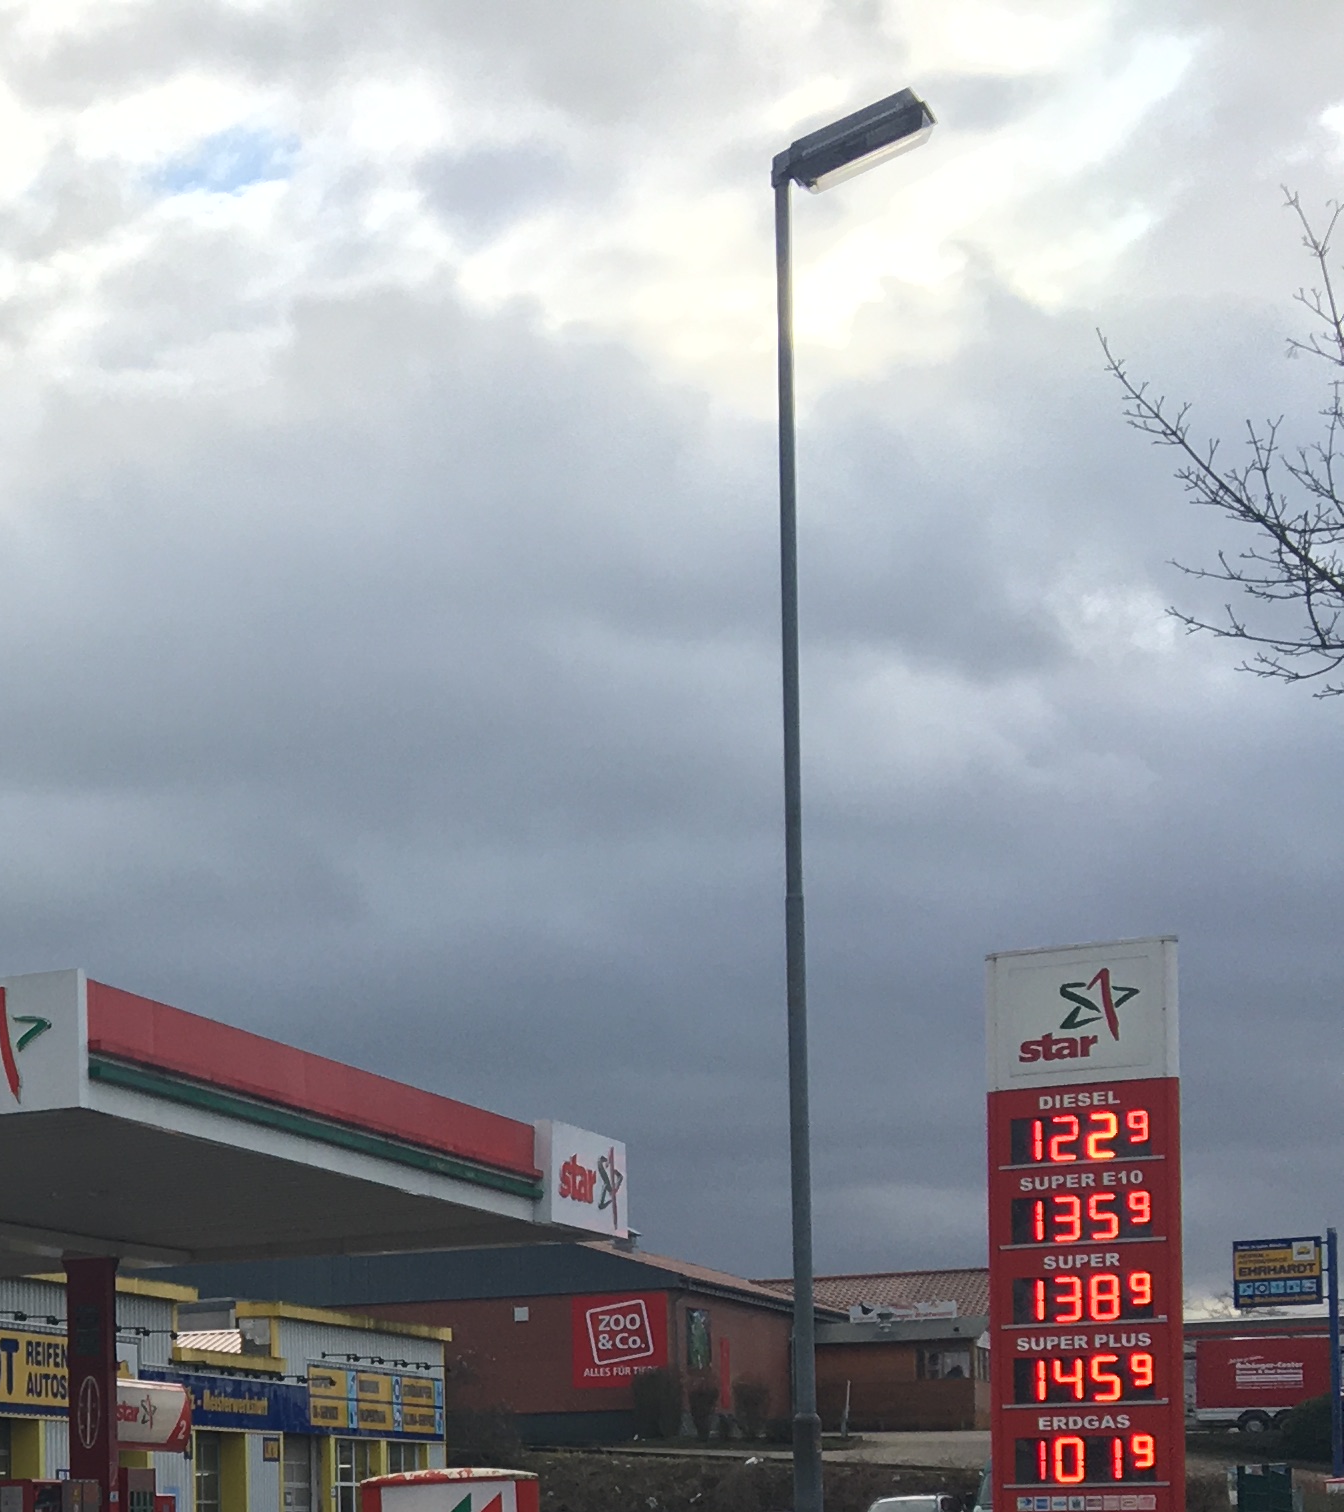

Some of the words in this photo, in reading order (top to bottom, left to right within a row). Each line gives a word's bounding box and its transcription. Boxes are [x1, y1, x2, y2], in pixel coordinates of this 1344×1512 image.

[1019, 1032, 1098, 1063] star
[1039, 1090, 1121, 1110] DIESEL
[558, 1153, 597, 1204] star
[1019, 1173, 1096, 1191] SUPER
[1102, 1170, 1144, 1186] E10
[1043, 1252, 1120, 1269] SUPER
[1238, 1263, 1316, 1277] EHRHARDT
[598, 1313, 641, 1331] ZOO
[597, 1333, 613, 1349] &
[615, 1332, 646, 1349] Co.
[1017, 1335, 1088, 1351] SUPER
[1094, 1332, 1152, 1348] PLUS
[583, 1367, 611, 1377] ALLES
[613, 1366, 631, 1376] FÜR
[177, 1420, 187, 1440] 2
[1038, 1414, 1131, 1431] ERDGAS
